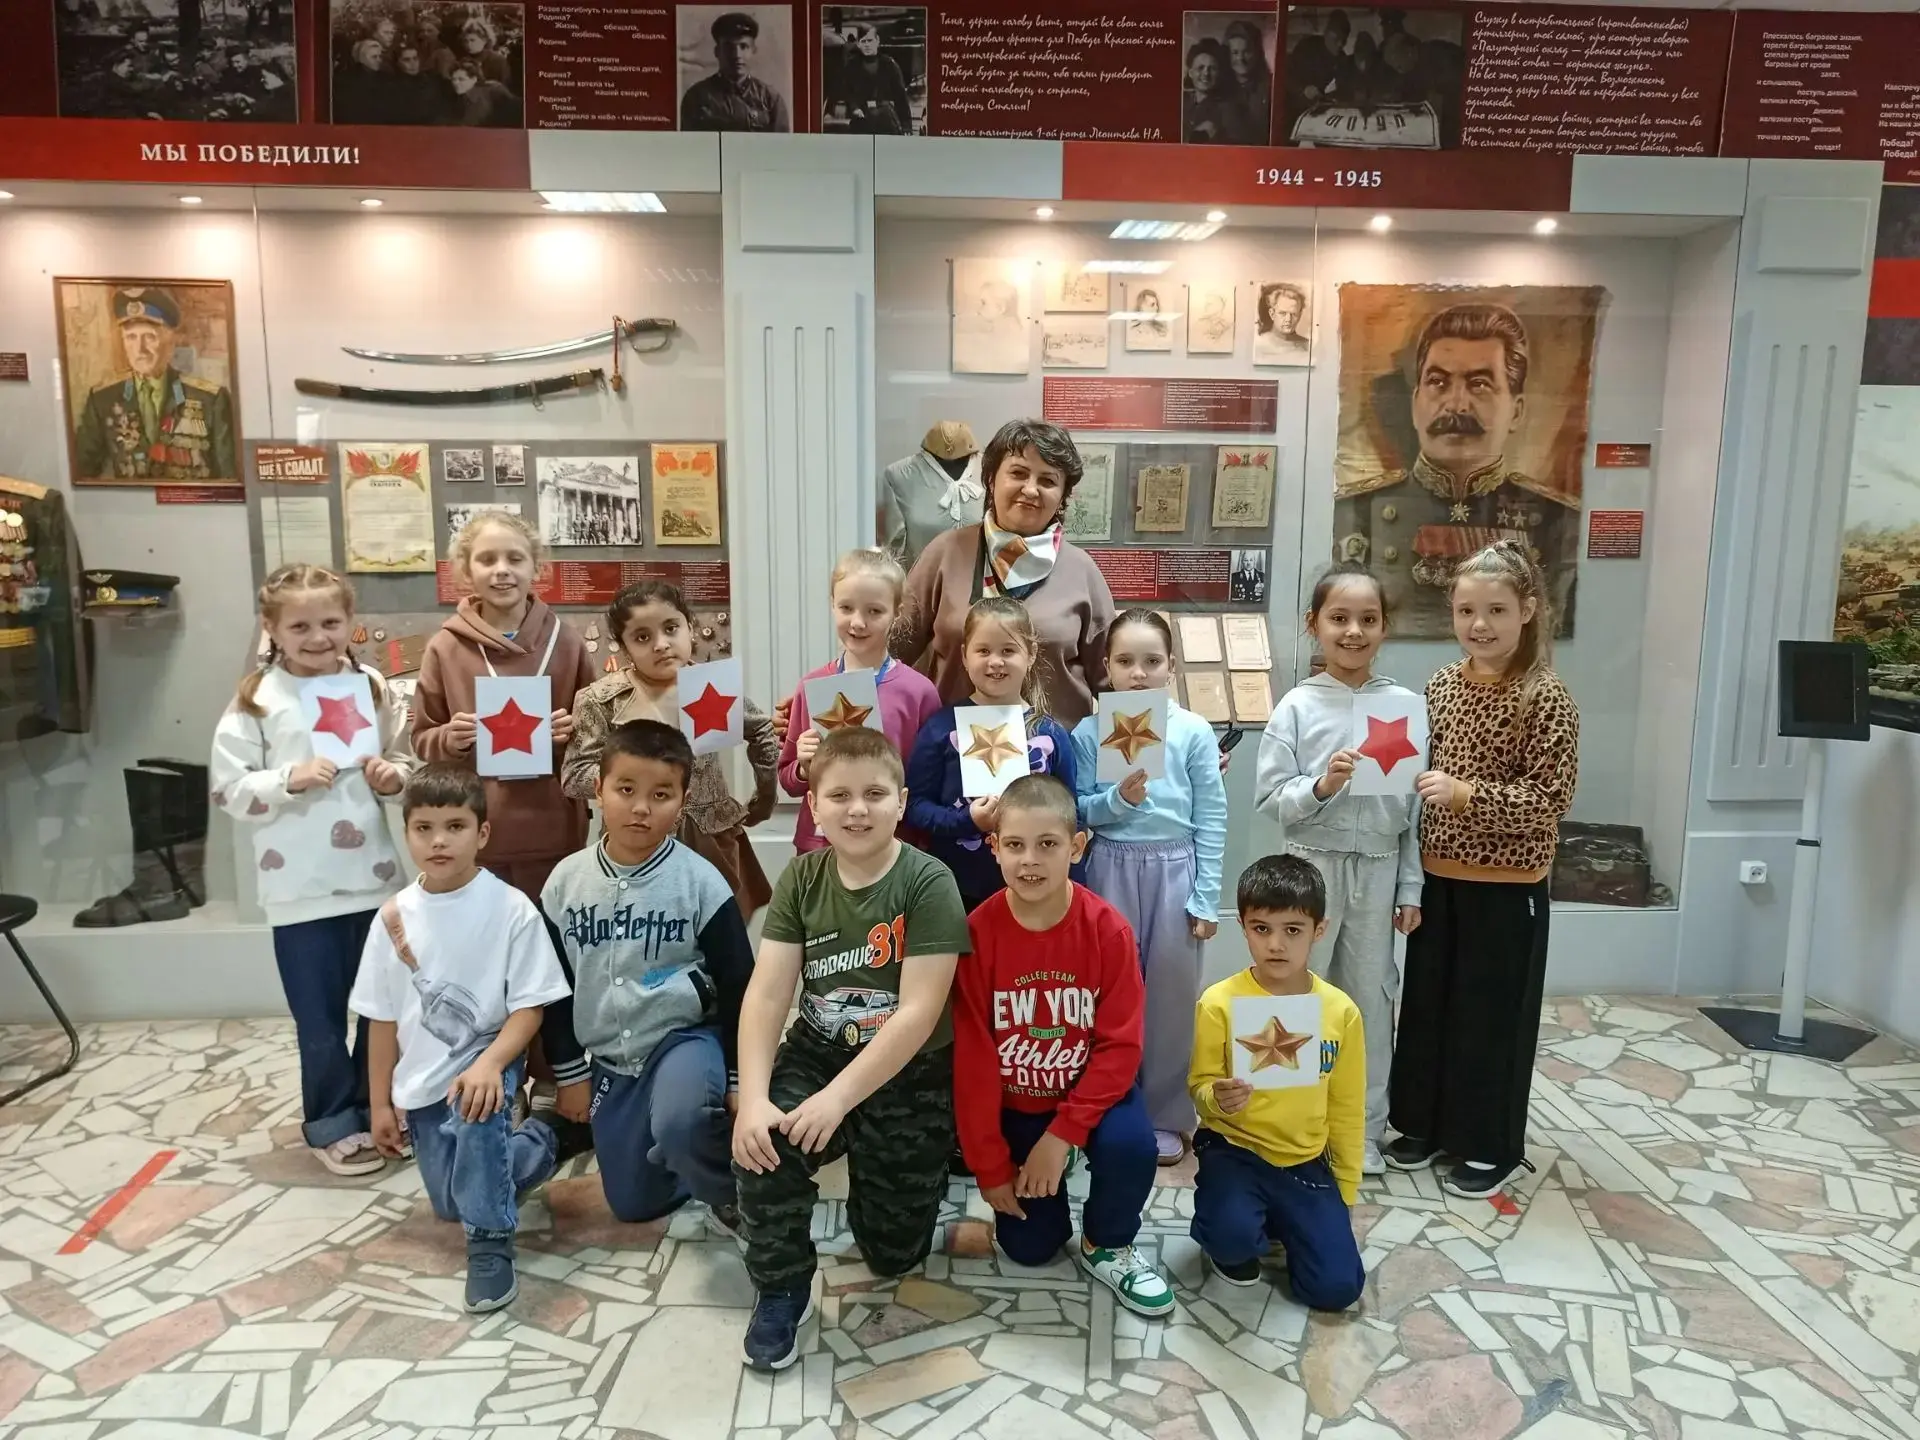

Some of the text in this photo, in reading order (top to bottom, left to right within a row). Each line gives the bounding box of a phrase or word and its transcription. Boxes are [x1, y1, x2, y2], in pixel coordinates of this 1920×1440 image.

[940, 12, 965, 28] Таня,
[968, 18, 1000, 30] держи
[1002, 14, 1032, 30] голову
[1035, 14, 1062, 28] выше,
[1066, 18, 1098, 31] отдай
[1116, 16, 1137, 28] свои
[1140, 20, 1164, 28] силы
[1474, 10, 1689, 31] Служу в истребительной (противотанковой)
[956, 31, 1004, 47] трудовом
[1006, 32, 1044, 47] фронте
[1046, 36, 1064, 48] для
[1067, 32, 1101, 48] Победы
[1104, 32, 1143, 48] Красной
[1146, 38, 1176, 48] армии
[1472, 28, 1530, 42] артиллерии,
[1533, 30, 1554, 39] той
[1556, 32, 1585, 43] самой,
[1608, 34, 1651, 46] которую
[1653, 32, 1690, 48] говорят
[941, 52, 958, 64] над
[962, 48, 1026, 64] гитлеровской
[1472, 40, 1541, 56] «Полуторный
[1542, 47, 1568, 58] оклад
[1584, 44, 1621, 59] двойная
[1624, 48, 1662, 60] смерть»
[1470, 54, 1653, 74] «Длинный ствол короткая жизнь».
[941, 64, 974, 80] Победа
[976, 66, 1006, 81] будет
[1008, 70, 1020, 82] за
[1022, 70, 1050, 80] нами,
[1053, 66, 1070, 78] ибо
[1100, 66, 1153, 84] руководит
[1469, 66, 1482, 79] Но
[1499, 72, 1520, 82] это,
[1522, 72, 1560, 82] конечно,
[1563, 74, 1597, 86] ерунда.
[1600, 71, 1665, 88] Возможность
[941, 81, 1090, 98] великий полководец стратег,
[1467, 85, 1513, 97] получить
[1516, 86, 1540, 99] дыру
[1542, 83, 1549, 95] в
[1550, 82, 1576, 96] голове
[1593, 86, 1636, 101] передовой
[1681, 87, 1700, 99] всех
[941, 98, 1031, 113] товарищ Сталин!
[1465, 96, 1515, 108] одинакова.
[1465, 107, 1485, 120] Что
[1488, 113, 1529, 121] касается
[1532, 114, 1560, 124] конца
[1562, 111, 1592, 124] войны,
[1596, 115, 1637, 127] который
[1640, 113, 1652, 125] вы
[1690, 114, 1702, 126] бы
[941, 126, 1163, 141] письмо политрука 1-ой роты Леонтьева Н.А.
[1464, 126, 1495, 136] знать,
[1556, 124, 1586, 139] вопрос
[1590, 126, 1637, 138] ответить
[1640, 130, 1678, 142] трудно.
[1880, 138, 1914, 147] Победа!
[140, 143, 360, 166] МЫ ПОБЕДИЛИ!
[1480, 140, 1520, 148] слишком
[1522, 137, 1553, 153] близко
[1555, 141, 1603, 154] находимся
[1614, 142, 1639, 151] этой
[1640, 140, 1671, 154] войны,
[1674, 142, 1704, 153] чтобы
[1883, 150, 1918, 158] Победа!
[1256, 168, 1304, 186] 1944
[1334, 170, 1382, 187] 1945
[867, 912, 905, 968] 81
[1050, 970, 1076, 983] TEAM
[1044, 987, 1100, 1031] YOR
[998, 1034, 1090, 1070] Athlet
